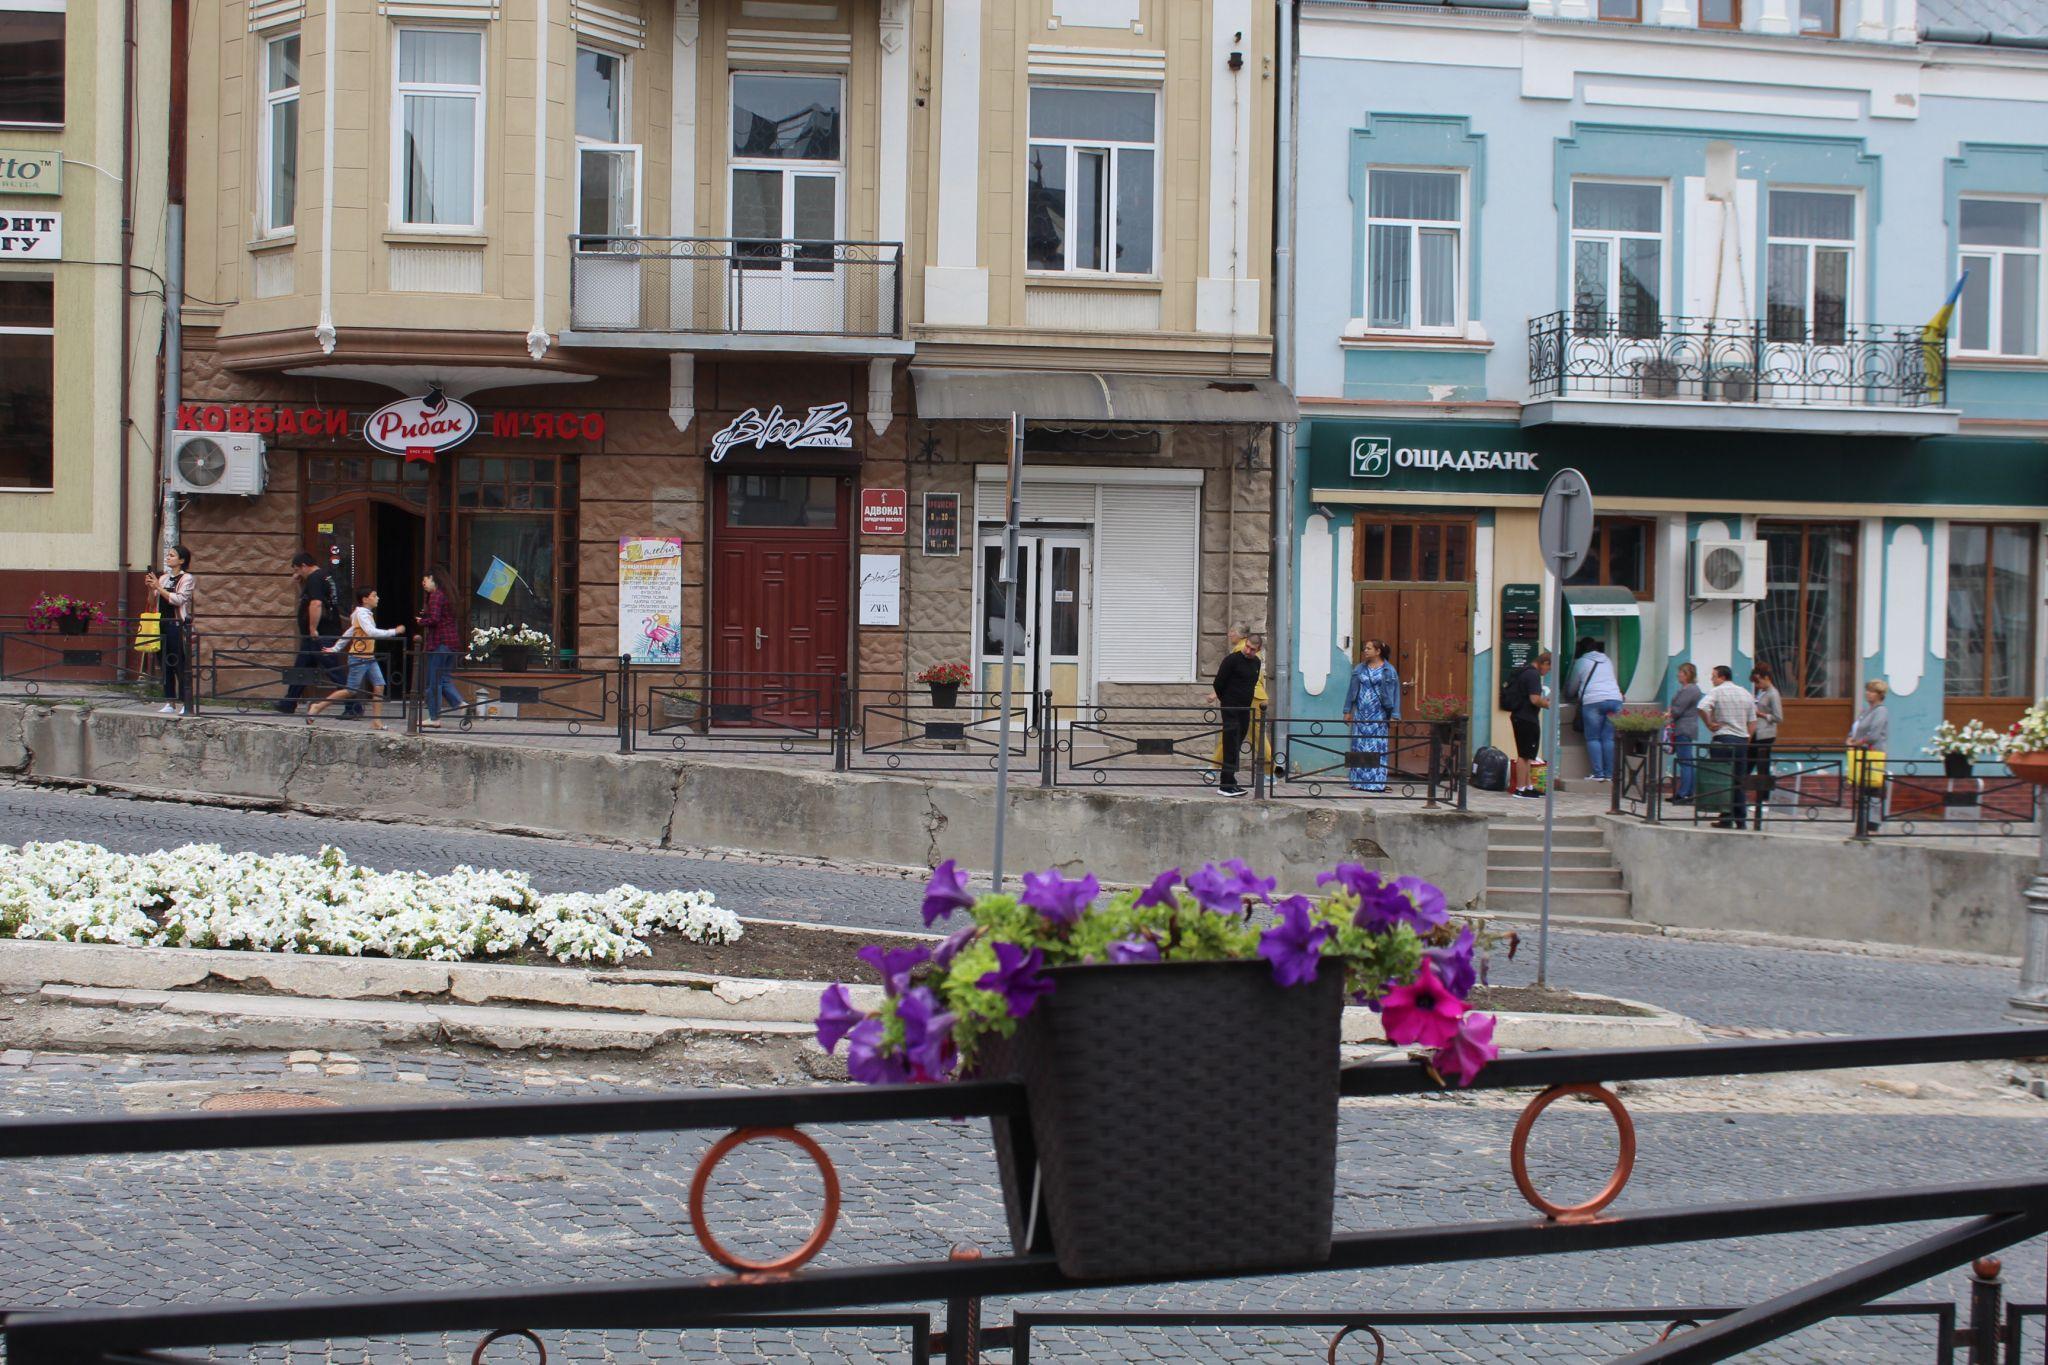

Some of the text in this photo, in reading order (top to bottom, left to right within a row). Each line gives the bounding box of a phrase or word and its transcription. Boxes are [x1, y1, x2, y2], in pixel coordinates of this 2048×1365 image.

[177, 404, 348, 435] КОВБАСИ
[377, 411, 462, 441] Рибак
[493, 411, 606, 441] М'ЯСО
[809, 437, 839, 446] ZARA
[1395, 448, 1540, 471] ОЩАДБАНК
[864, 506, 904, 517] АДВОКАТ
